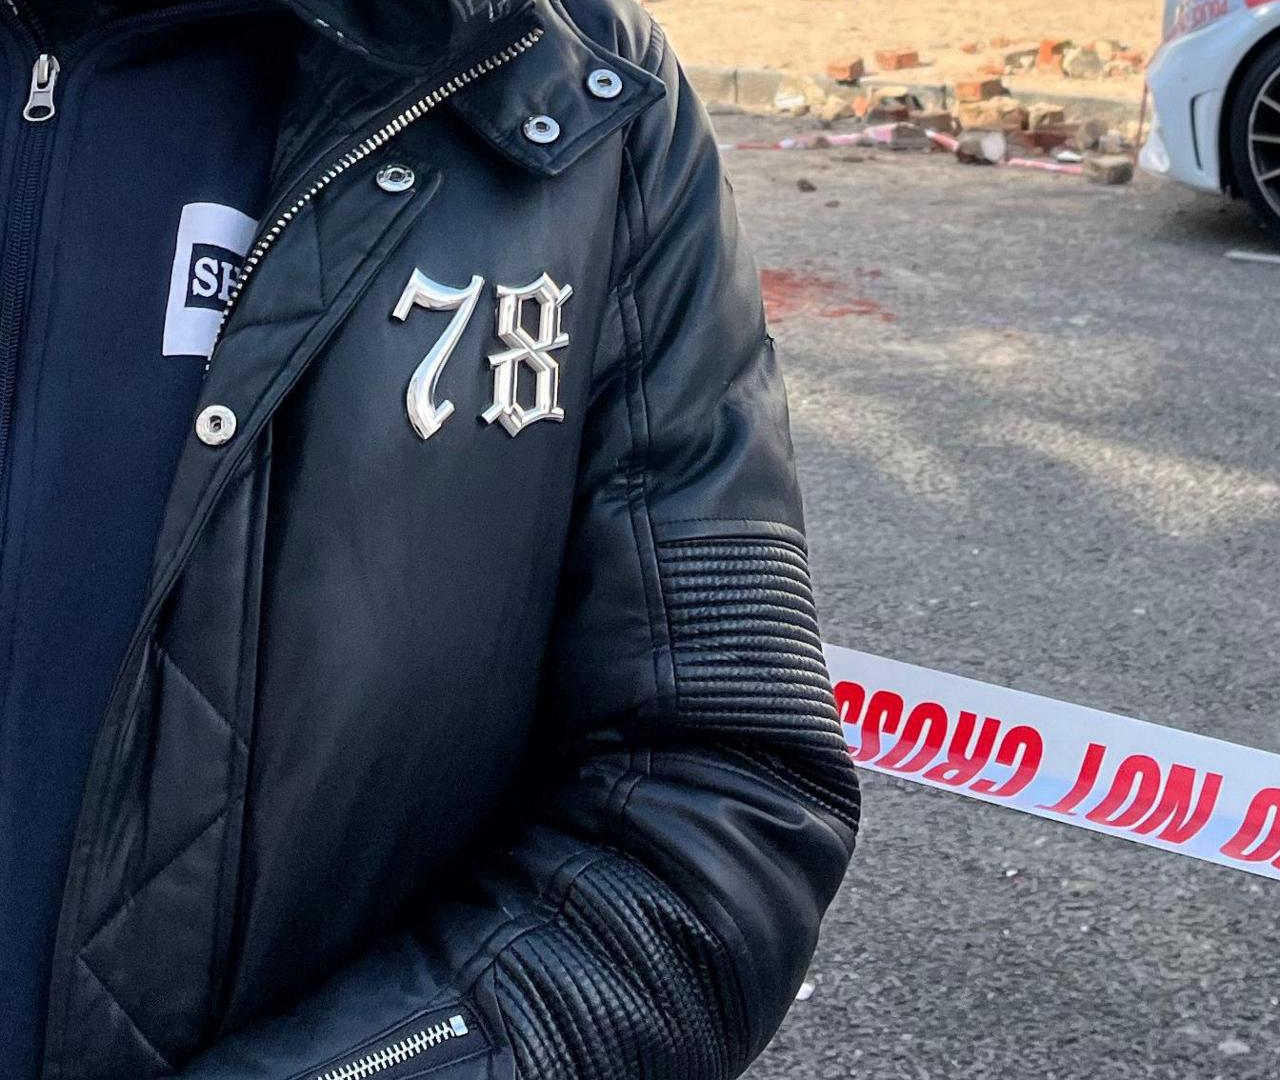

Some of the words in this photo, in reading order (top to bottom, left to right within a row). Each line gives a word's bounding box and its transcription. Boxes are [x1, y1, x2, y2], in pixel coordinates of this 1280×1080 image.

[392, 266, 573, 440] 78
[832, 680, 1044, 797] CROSS
[1052, 743, 1223, 844] NOT
